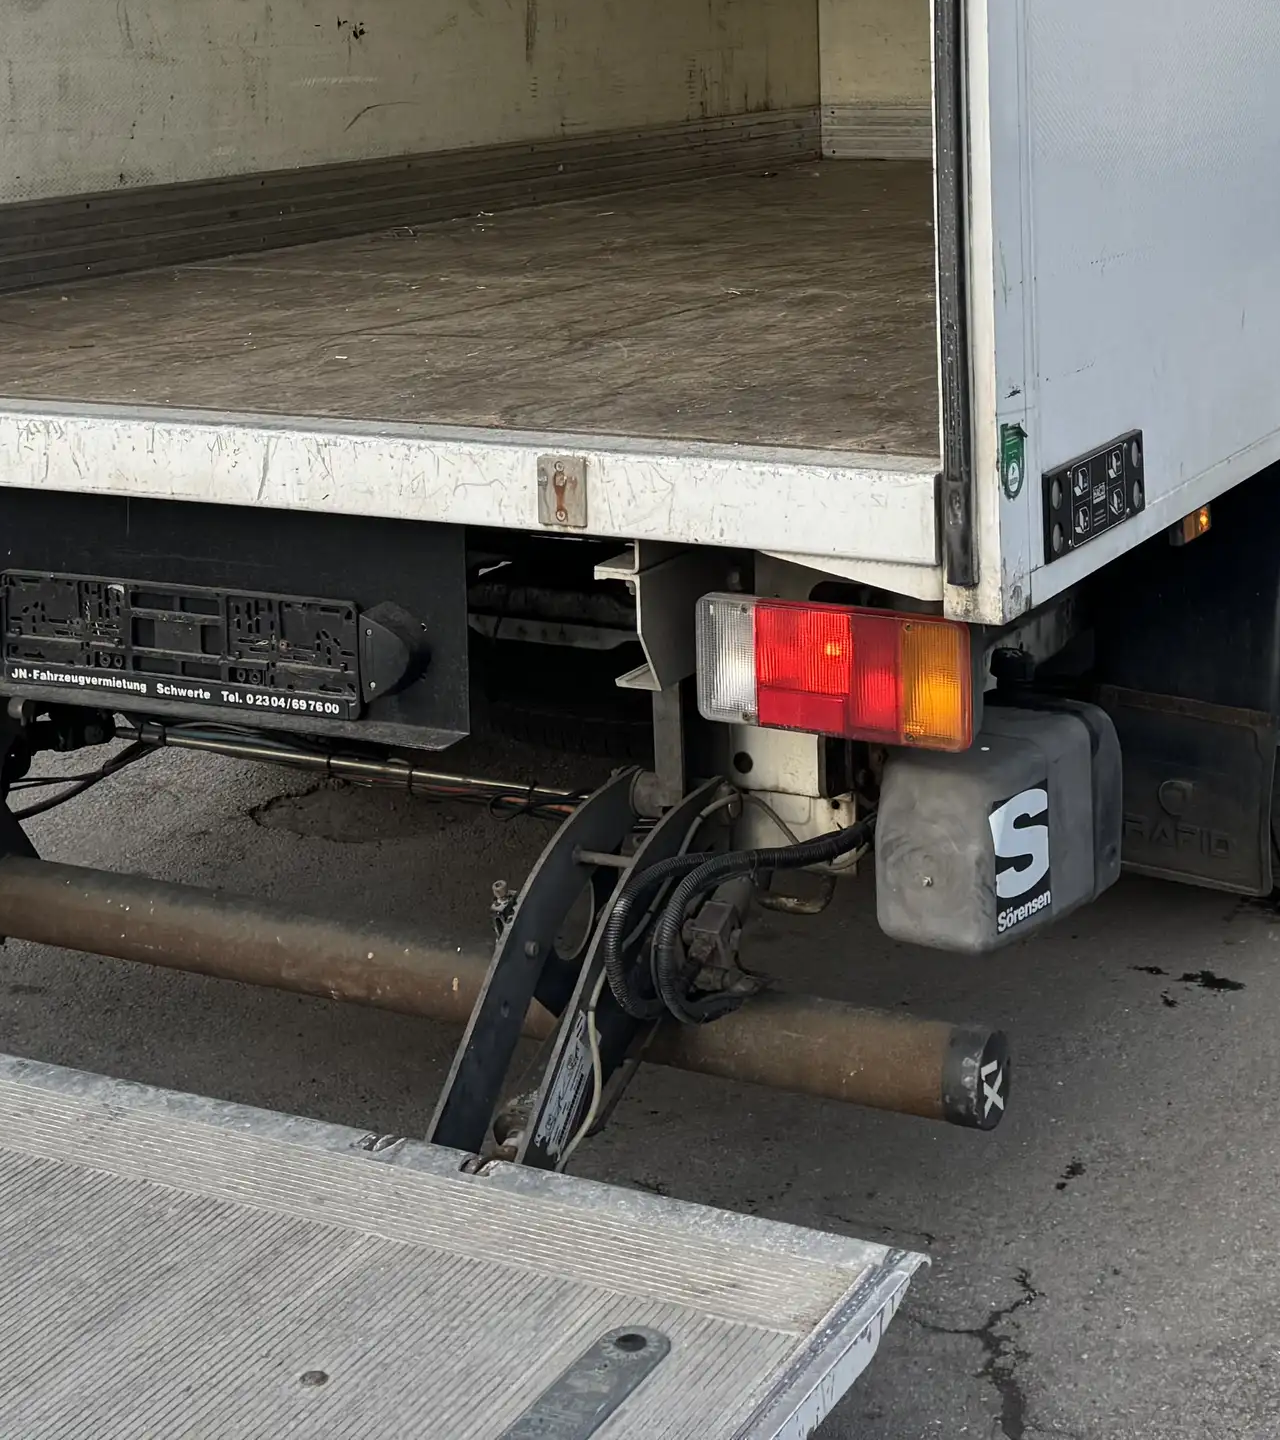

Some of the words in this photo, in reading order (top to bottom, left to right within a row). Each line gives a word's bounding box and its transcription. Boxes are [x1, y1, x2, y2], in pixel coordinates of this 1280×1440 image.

[156, 682, 211, 700] Schwerte
[221, 690, 243, 704] Tel.
[988, 788, 1050, 899] S
[997, 889, 1051, 933] Sörensen
